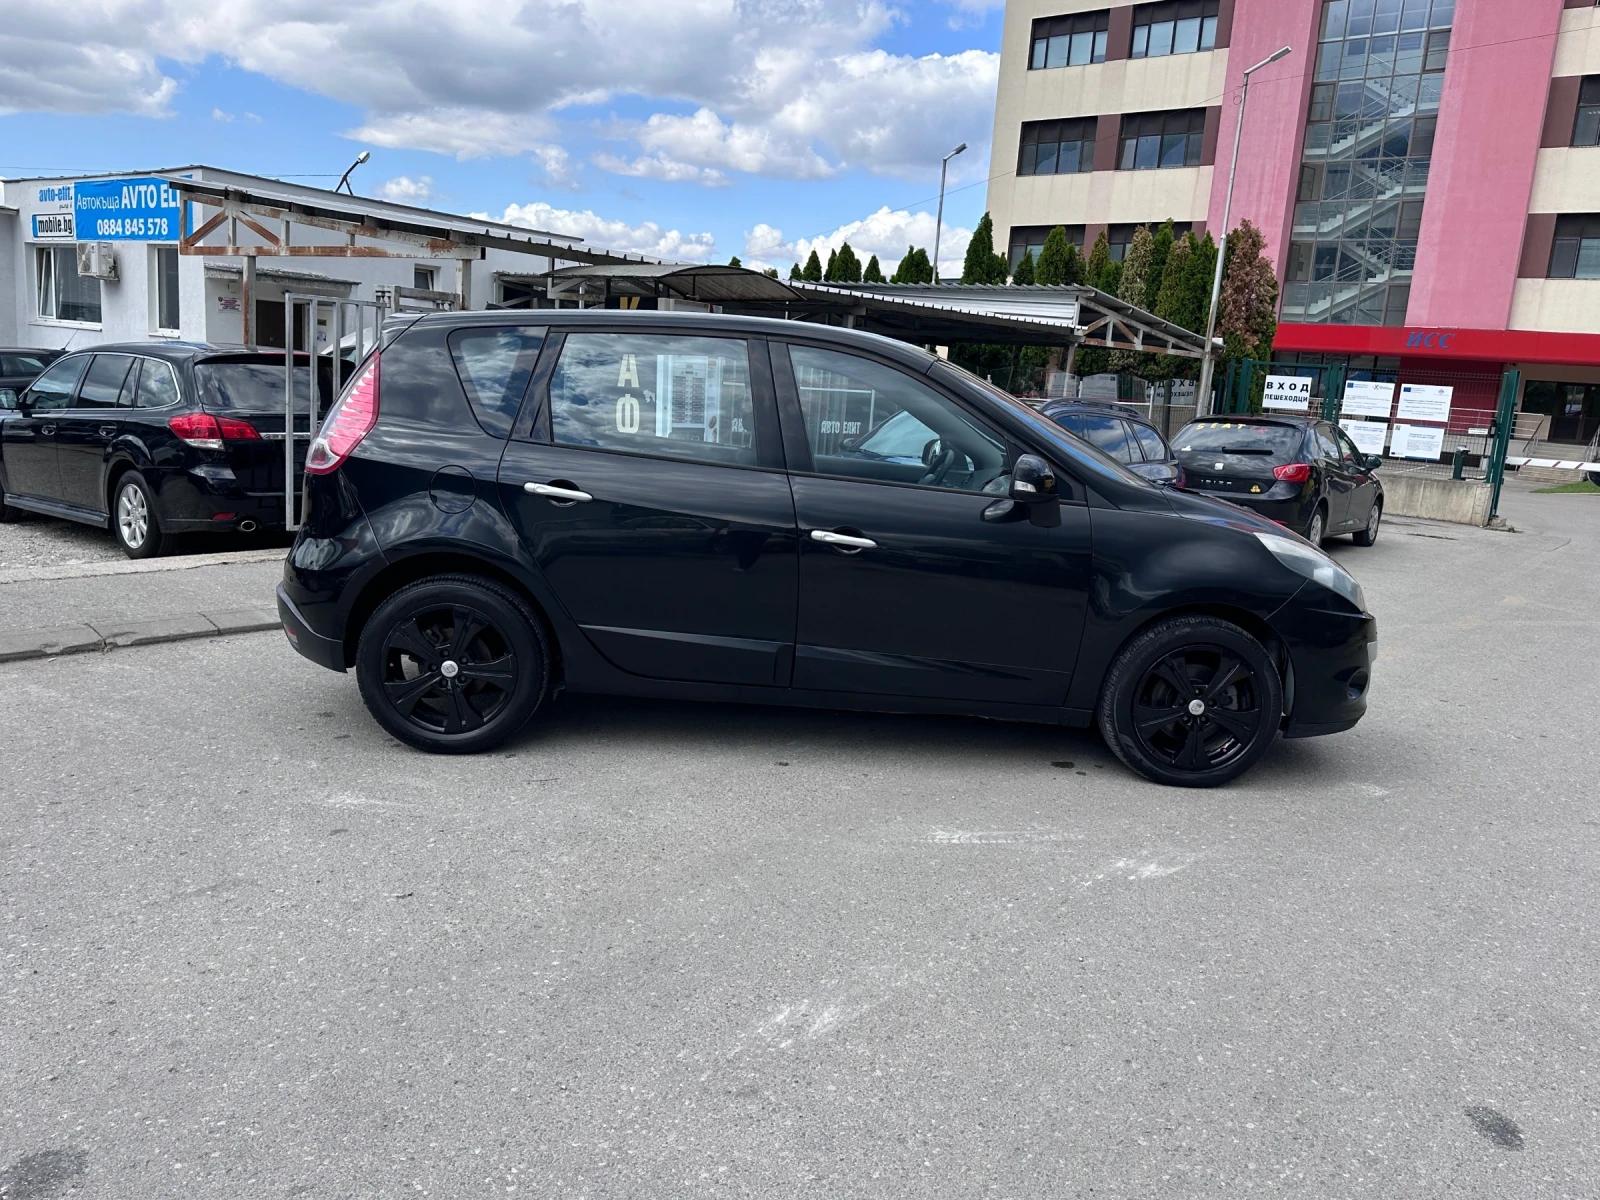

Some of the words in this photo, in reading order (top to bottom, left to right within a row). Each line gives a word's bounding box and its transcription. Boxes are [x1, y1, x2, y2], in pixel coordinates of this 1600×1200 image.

[77, 194, 119, 211] Автокъща
[121, 184, 157, 208] AVTO
[38, 216, 73, 234] mobile.bg
[97, 218, 122, 235] 0884
[125, 218, 144, 235] 845
[147, 217, 168, 235] 578
[1406, 331, 1456, 349] ИСС
[1266, 381, 1309, 393] ВХОД
[1264, 393, 1308, 402] ПЕШЕХОДЦИ
[821, 420, 840, 434] АВТО
[1196, 422, 1246, 430] SEAT
